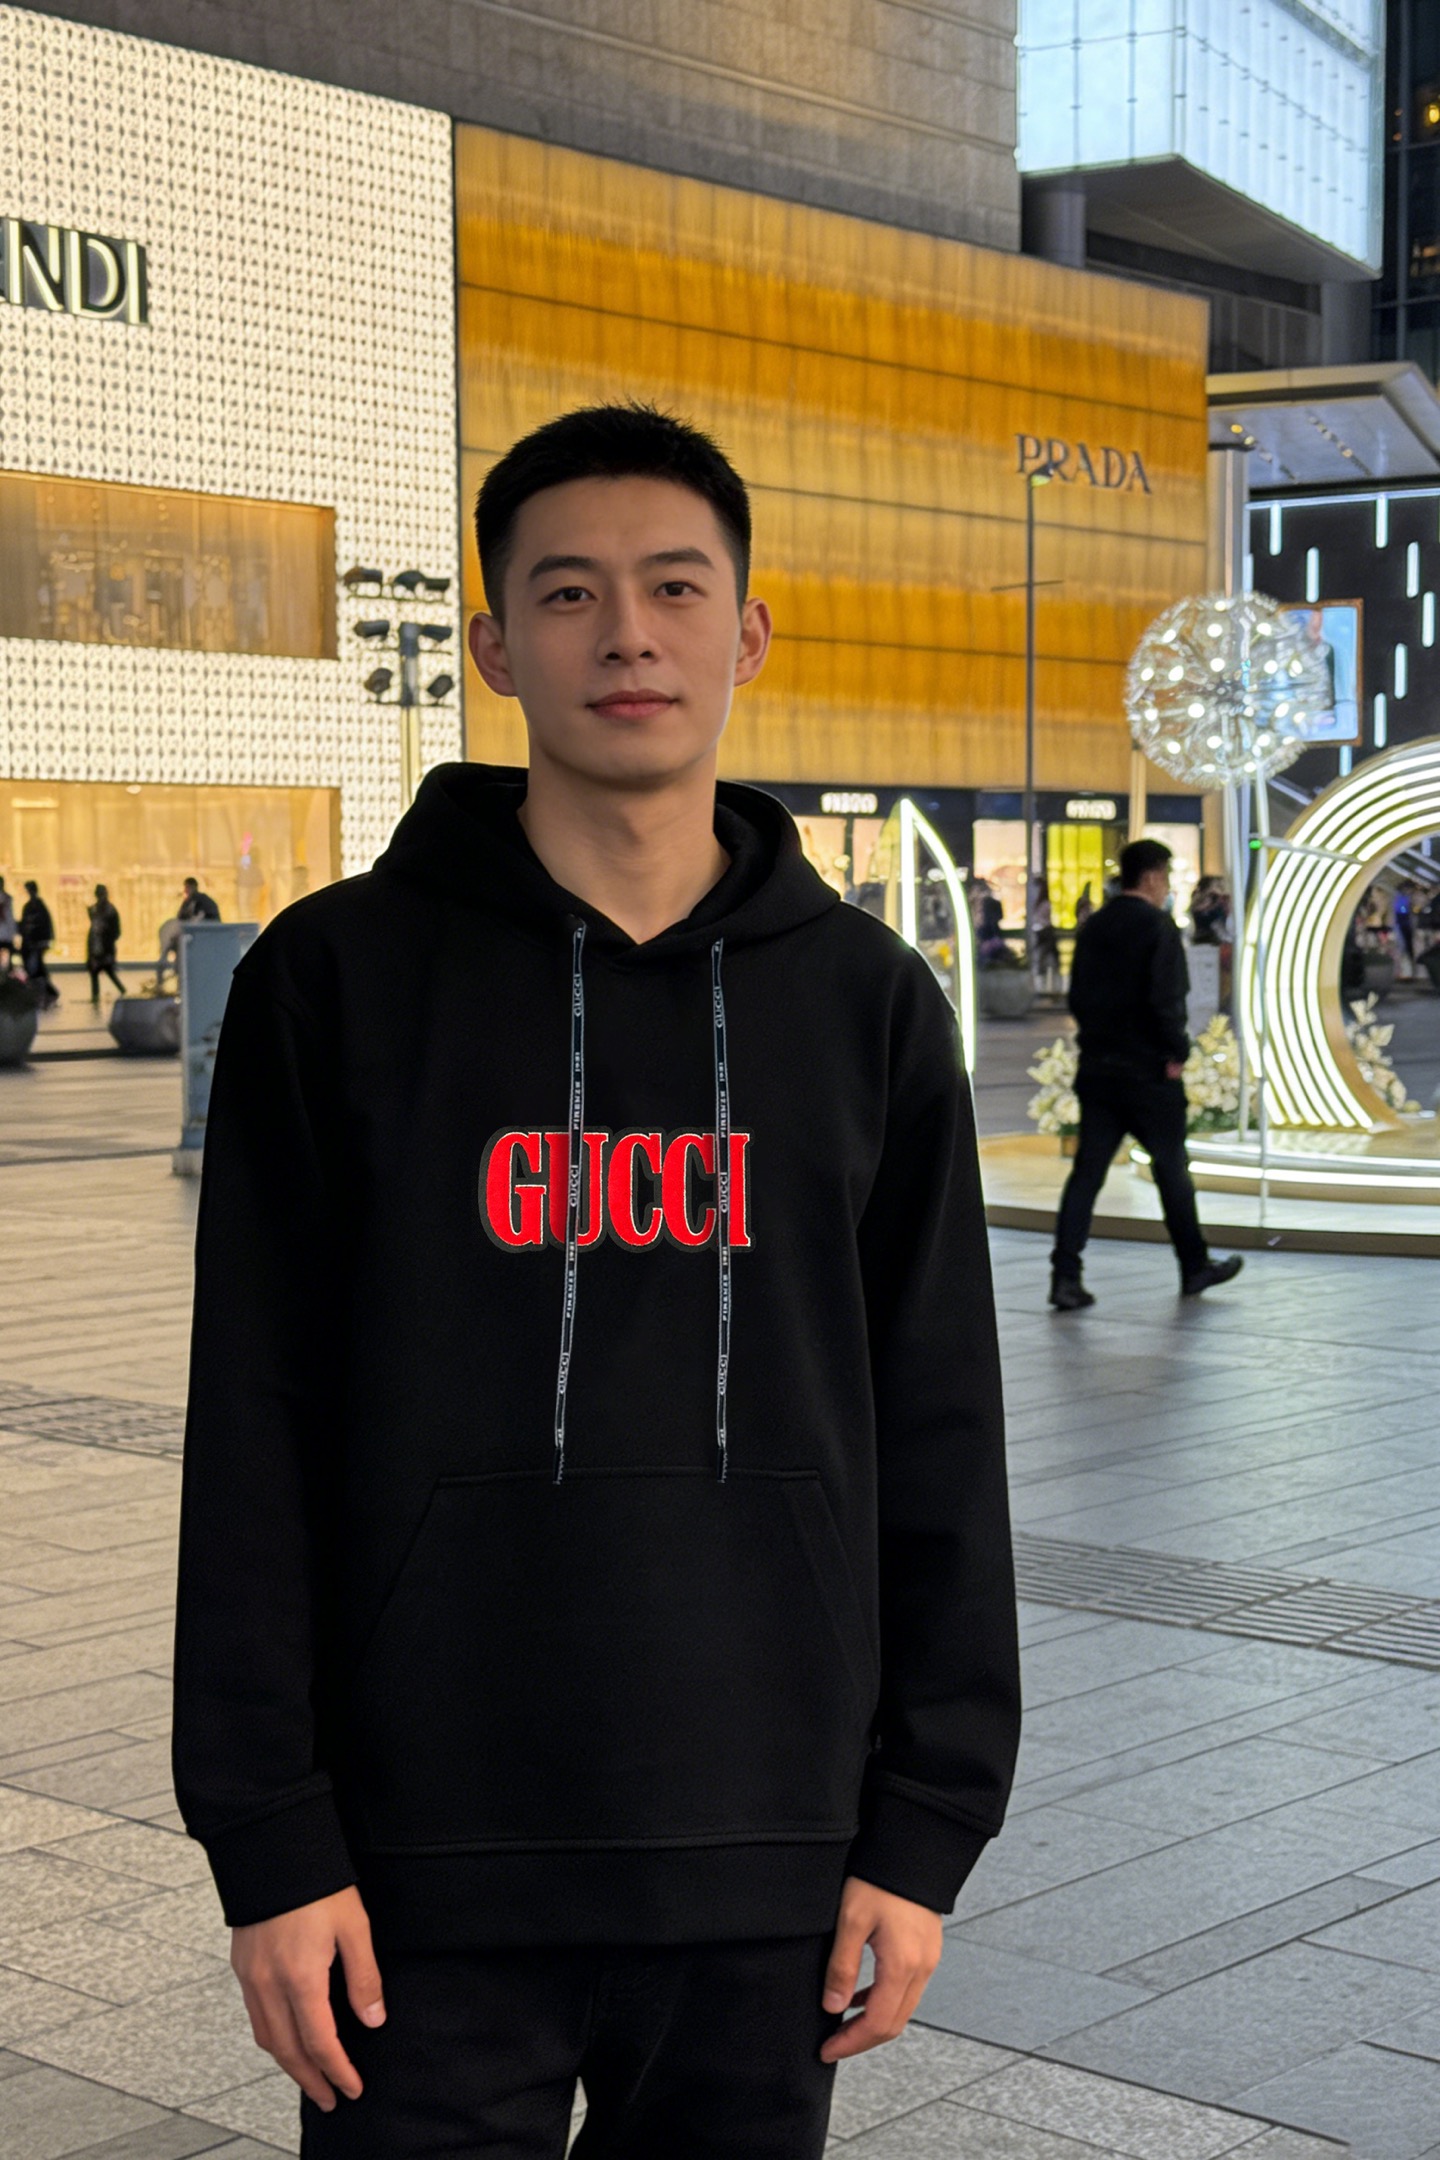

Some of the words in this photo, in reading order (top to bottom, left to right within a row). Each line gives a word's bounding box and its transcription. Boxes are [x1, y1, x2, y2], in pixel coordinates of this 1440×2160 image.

[0, 216, 148, 326] NDI
[1015, 432, 1152, 495] PRADA
[573, 973, 583, 1018] GUCCI
[714, 985, 724, 1029] GUCCI
[485, 1131, 751, 1247] GUCCI
[568, 1164, 580, 1208] GUCCI
[718, 1171, 729, 1214] GUCCI
